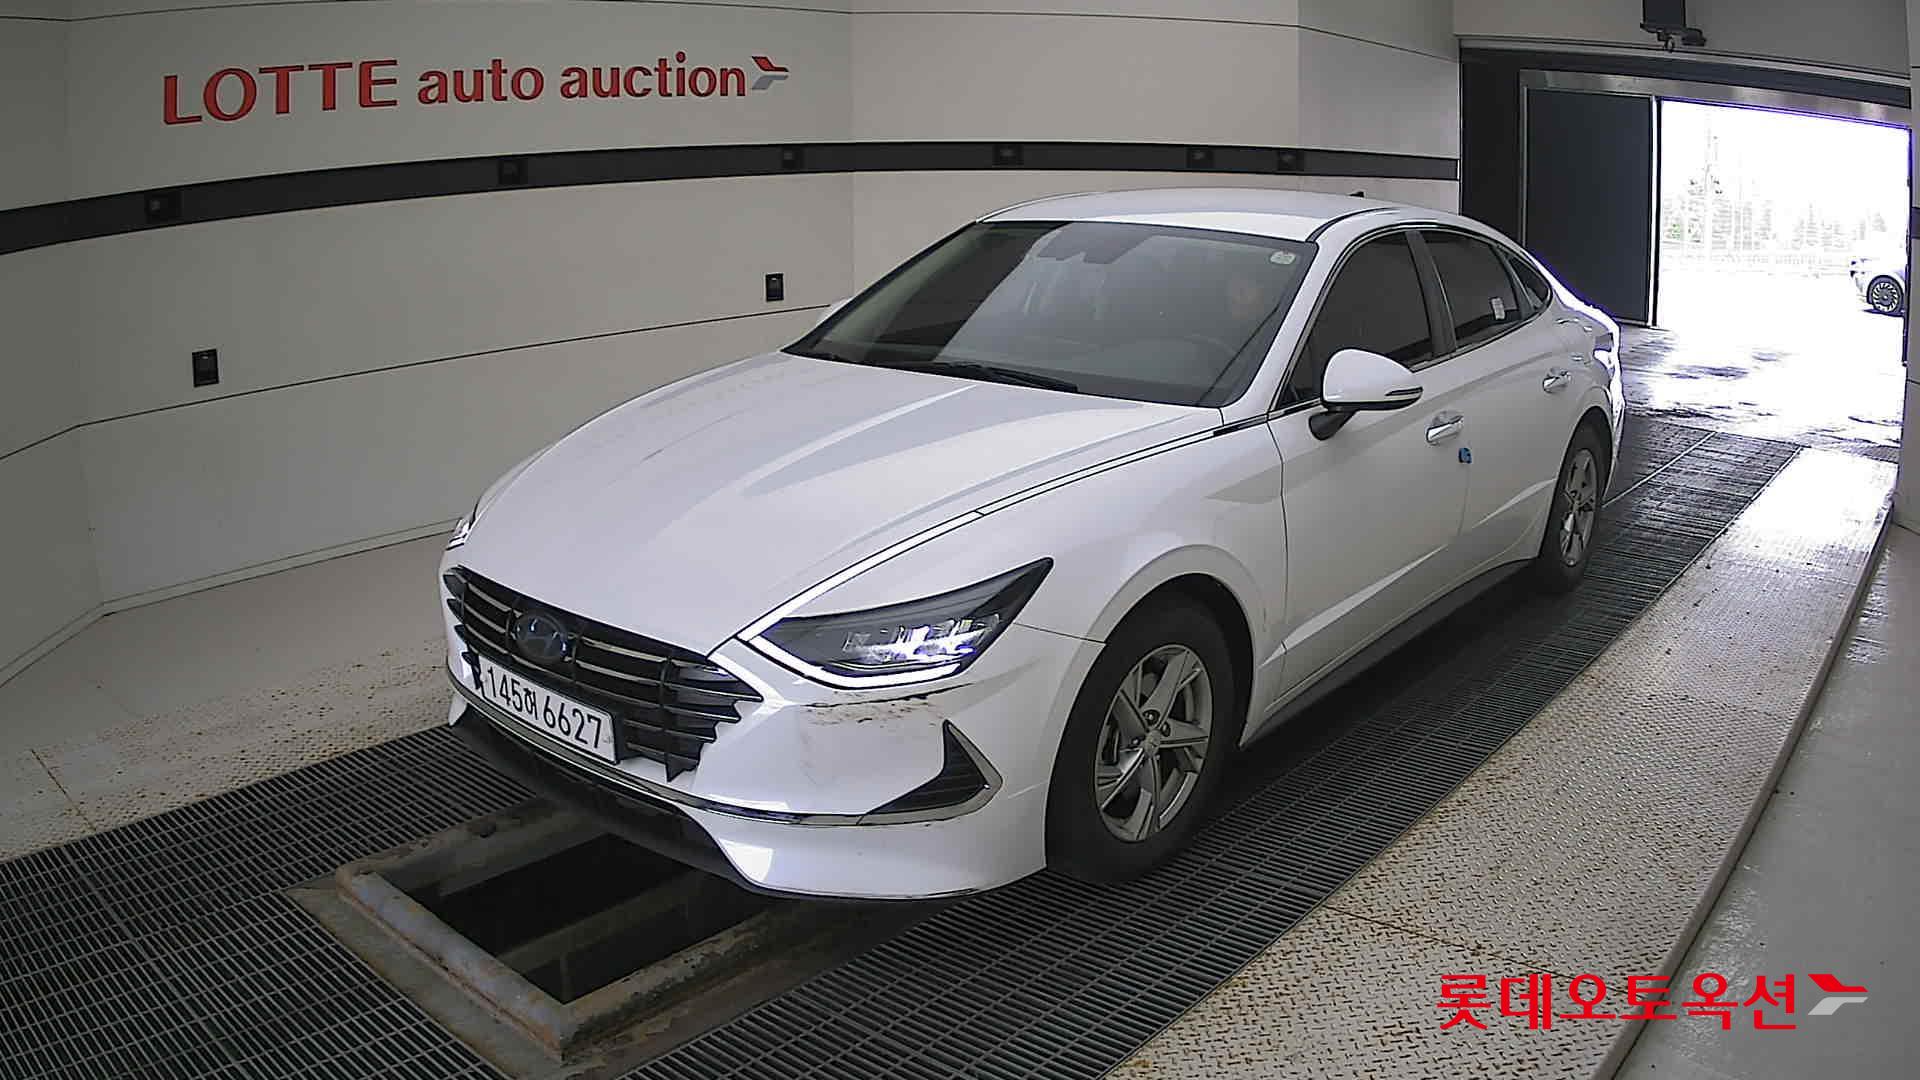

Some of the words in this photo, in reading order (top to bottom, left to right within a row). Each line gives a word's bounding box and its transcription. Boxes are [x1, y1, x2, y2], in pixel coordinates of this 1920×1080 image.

[163, 59, 398, 125] LOTTE
[418, 59, 545, 104] auto
[560, 51, 747, 98] auction
[543, 695, 602, 749] 6627
